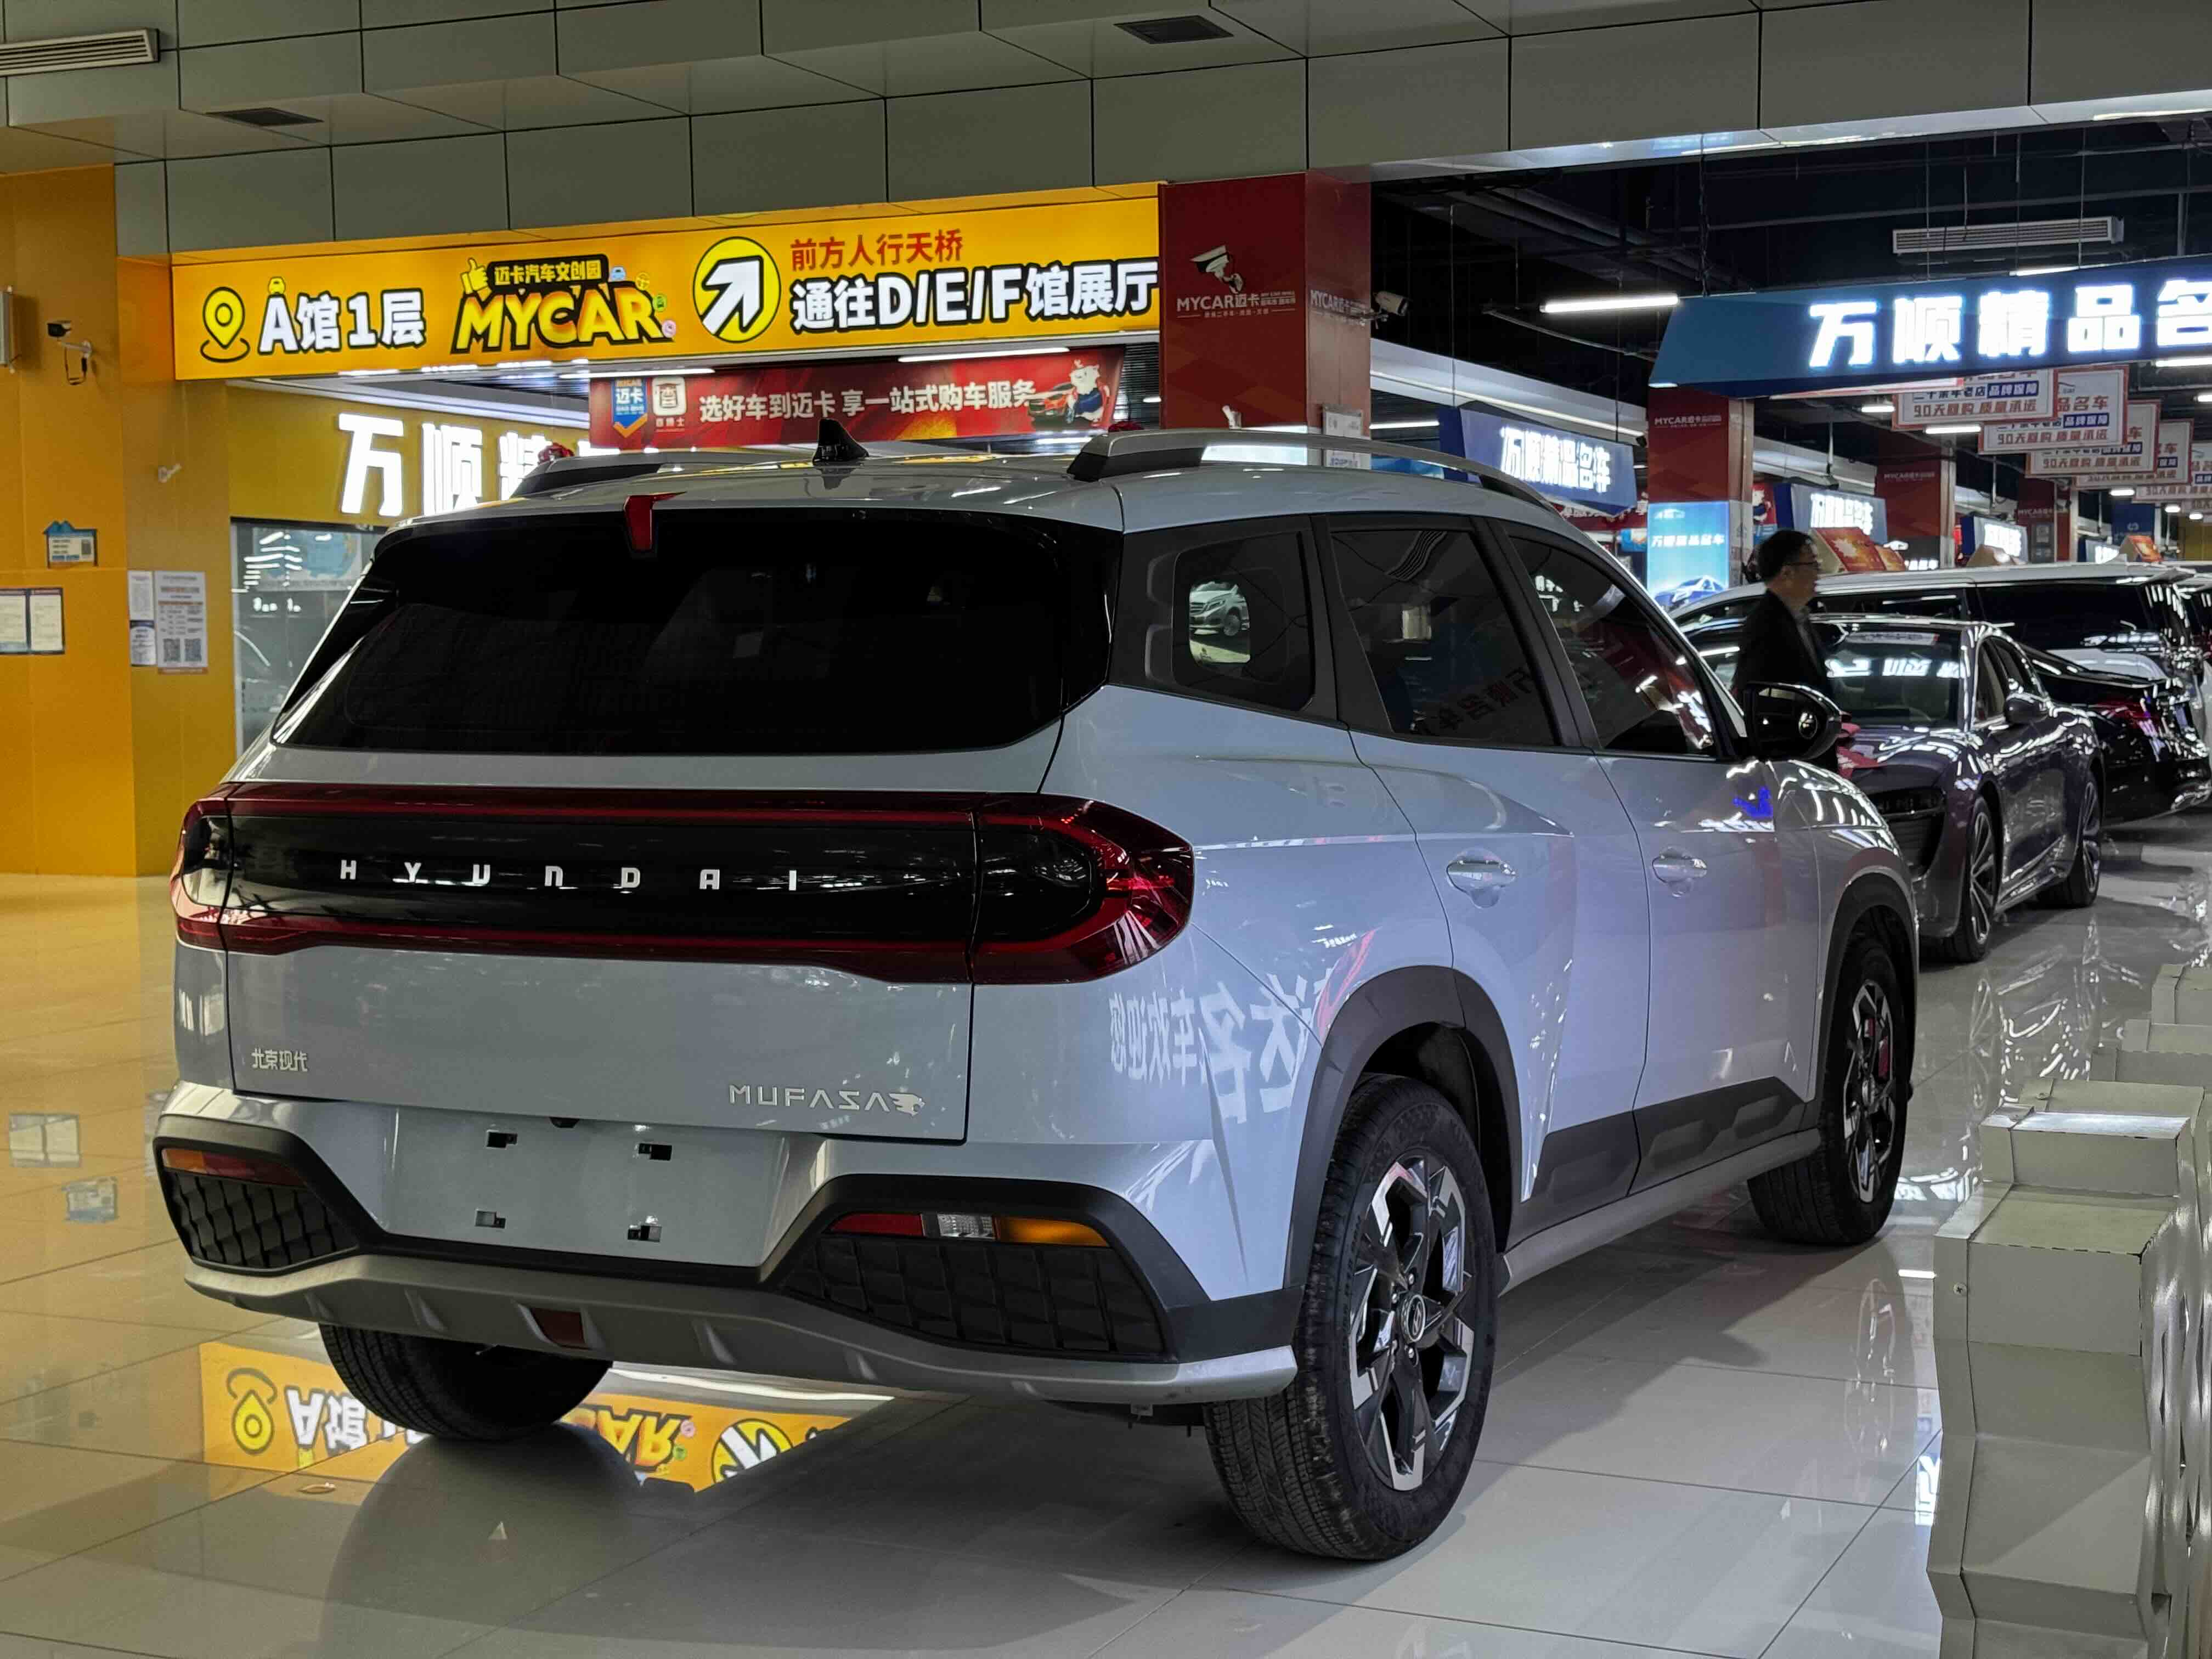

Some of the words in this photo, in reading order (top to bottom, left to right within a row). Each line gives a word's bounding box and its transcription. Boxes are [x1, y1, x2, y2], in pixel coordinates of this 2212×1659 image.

[494, 260, 602, 283] 迈卡汽车文创园
[790, 229, 963, 271] 前方人行天桥
[792, 261, 1159, 330] 通往D/E/F馆展厅
[258, 289, 425, 354] A馆1层
[454, 286, 670, 353] MYCAR
[1809, 279, 2212, 368] 万顺精品名
[699, 390, 836, 424] 选好车到迈卡
[842, 379, 1037, 415] 享一站式购车服务
[338, 413, 620, 516] 万顺精
[340, 859, 798, 891] HYUNDAI
[251, 1047, 308, 1071] 北京现代
[729, 1085, 891, 1113] MUFASA
